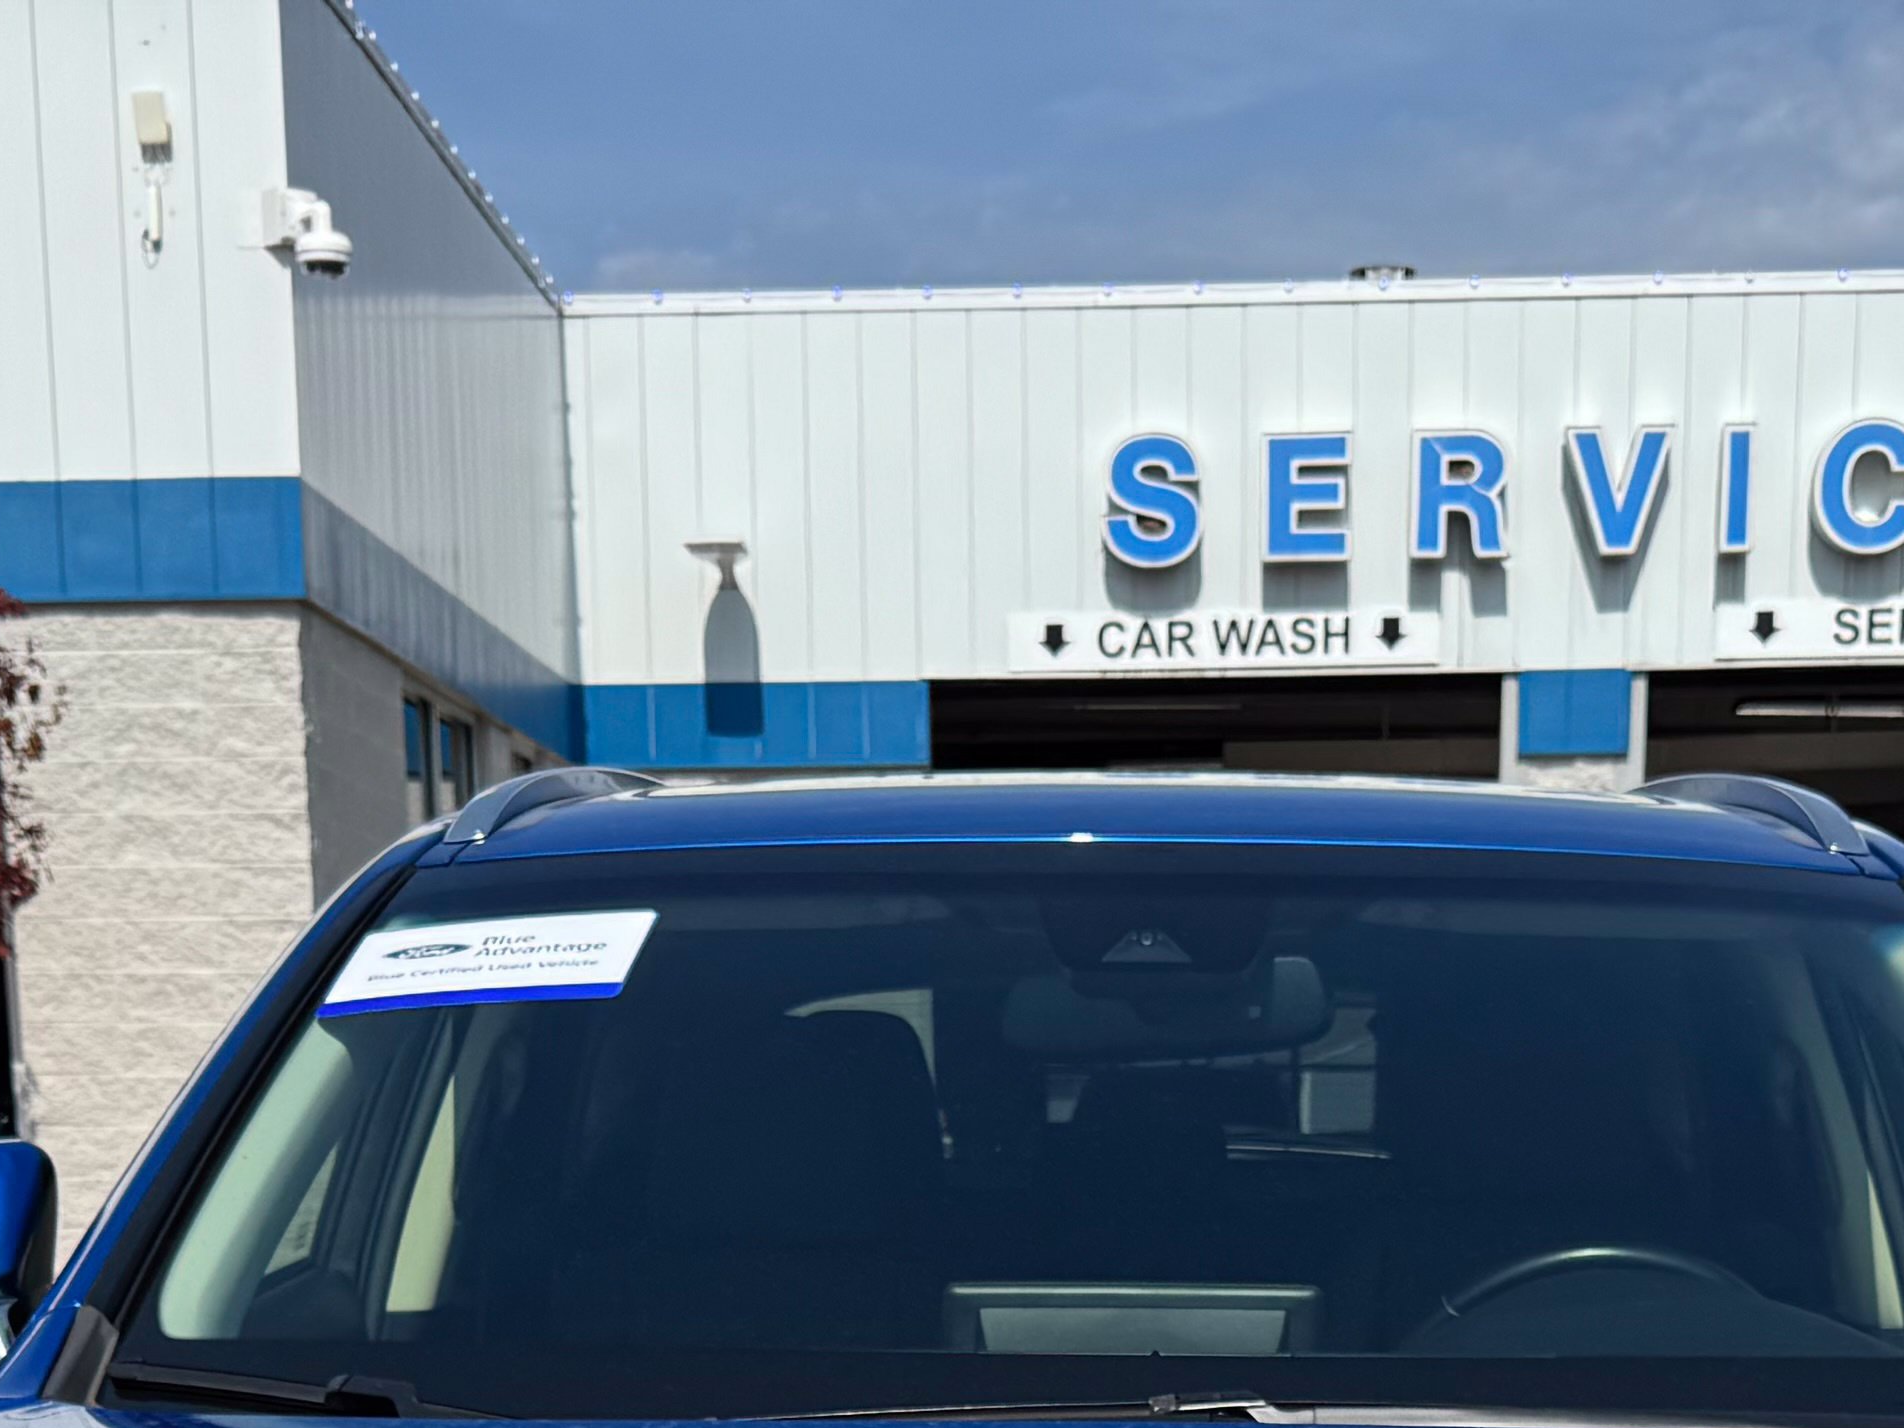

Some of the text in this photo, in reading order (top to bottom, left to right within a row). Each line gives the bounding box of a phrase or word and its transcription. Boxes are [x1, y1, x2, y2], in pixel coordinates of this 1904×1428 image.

[1097, 616, 1350, 658] CAR WASH
[473, 942, 608, 957] Advantage
